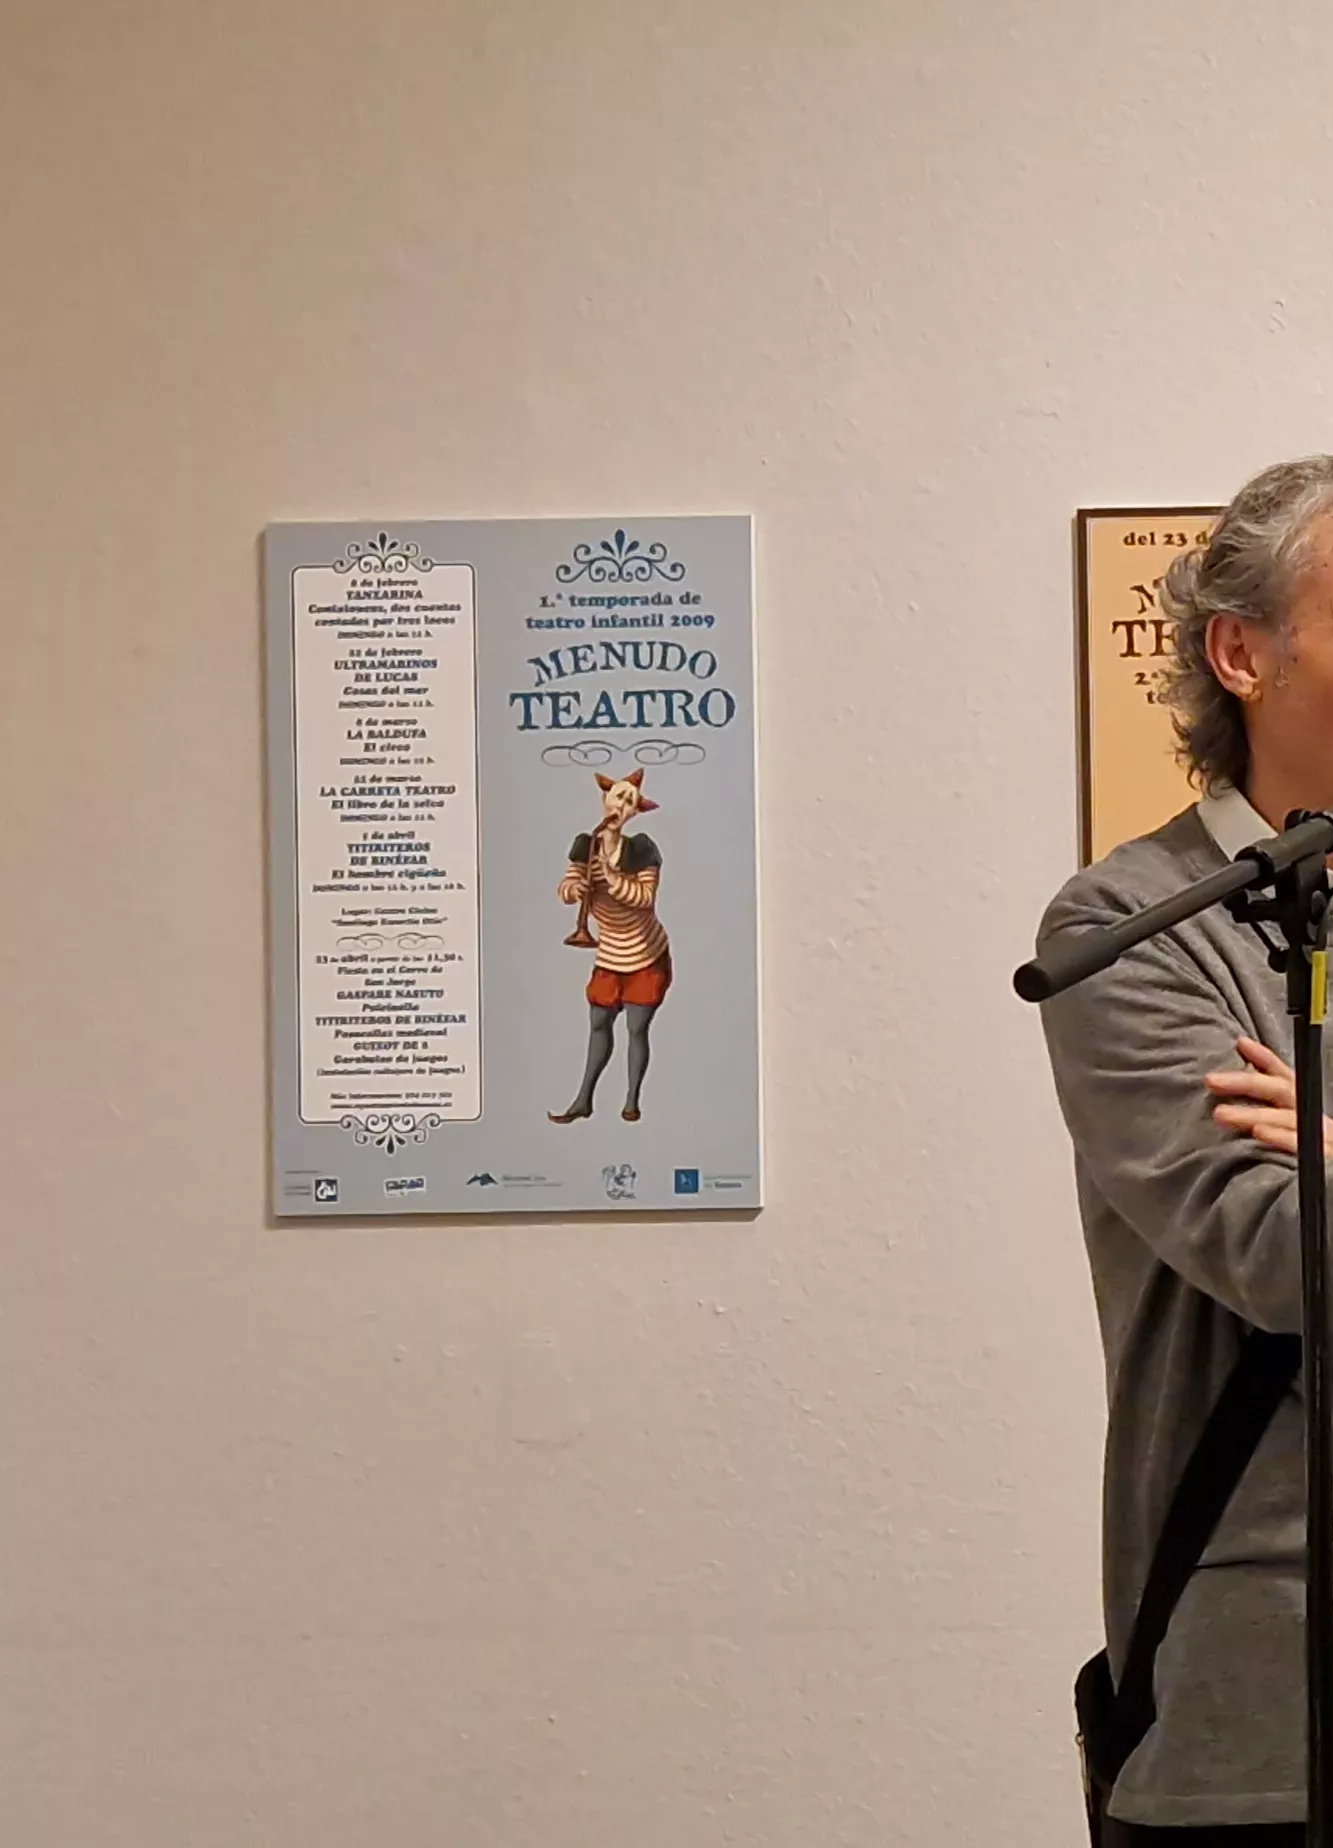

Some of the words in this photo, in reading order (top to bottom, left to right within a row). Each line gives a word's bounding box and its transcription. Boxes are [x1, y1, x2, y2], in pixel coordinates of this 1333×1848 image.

[1123, 532, 1155, 545] del
[1164, 533, 1187, 547] 23
[569, 594, 673, 608] temporada
[679, 592, 701, 604] de
[526, 618, 585, 629] teatro
[592, 614, 663, 628] infantil
[671, 615, 715, 627] 2009
[527, 642, 718, 685] MENUDO
[509, 690, 735, 729] TEATRO
